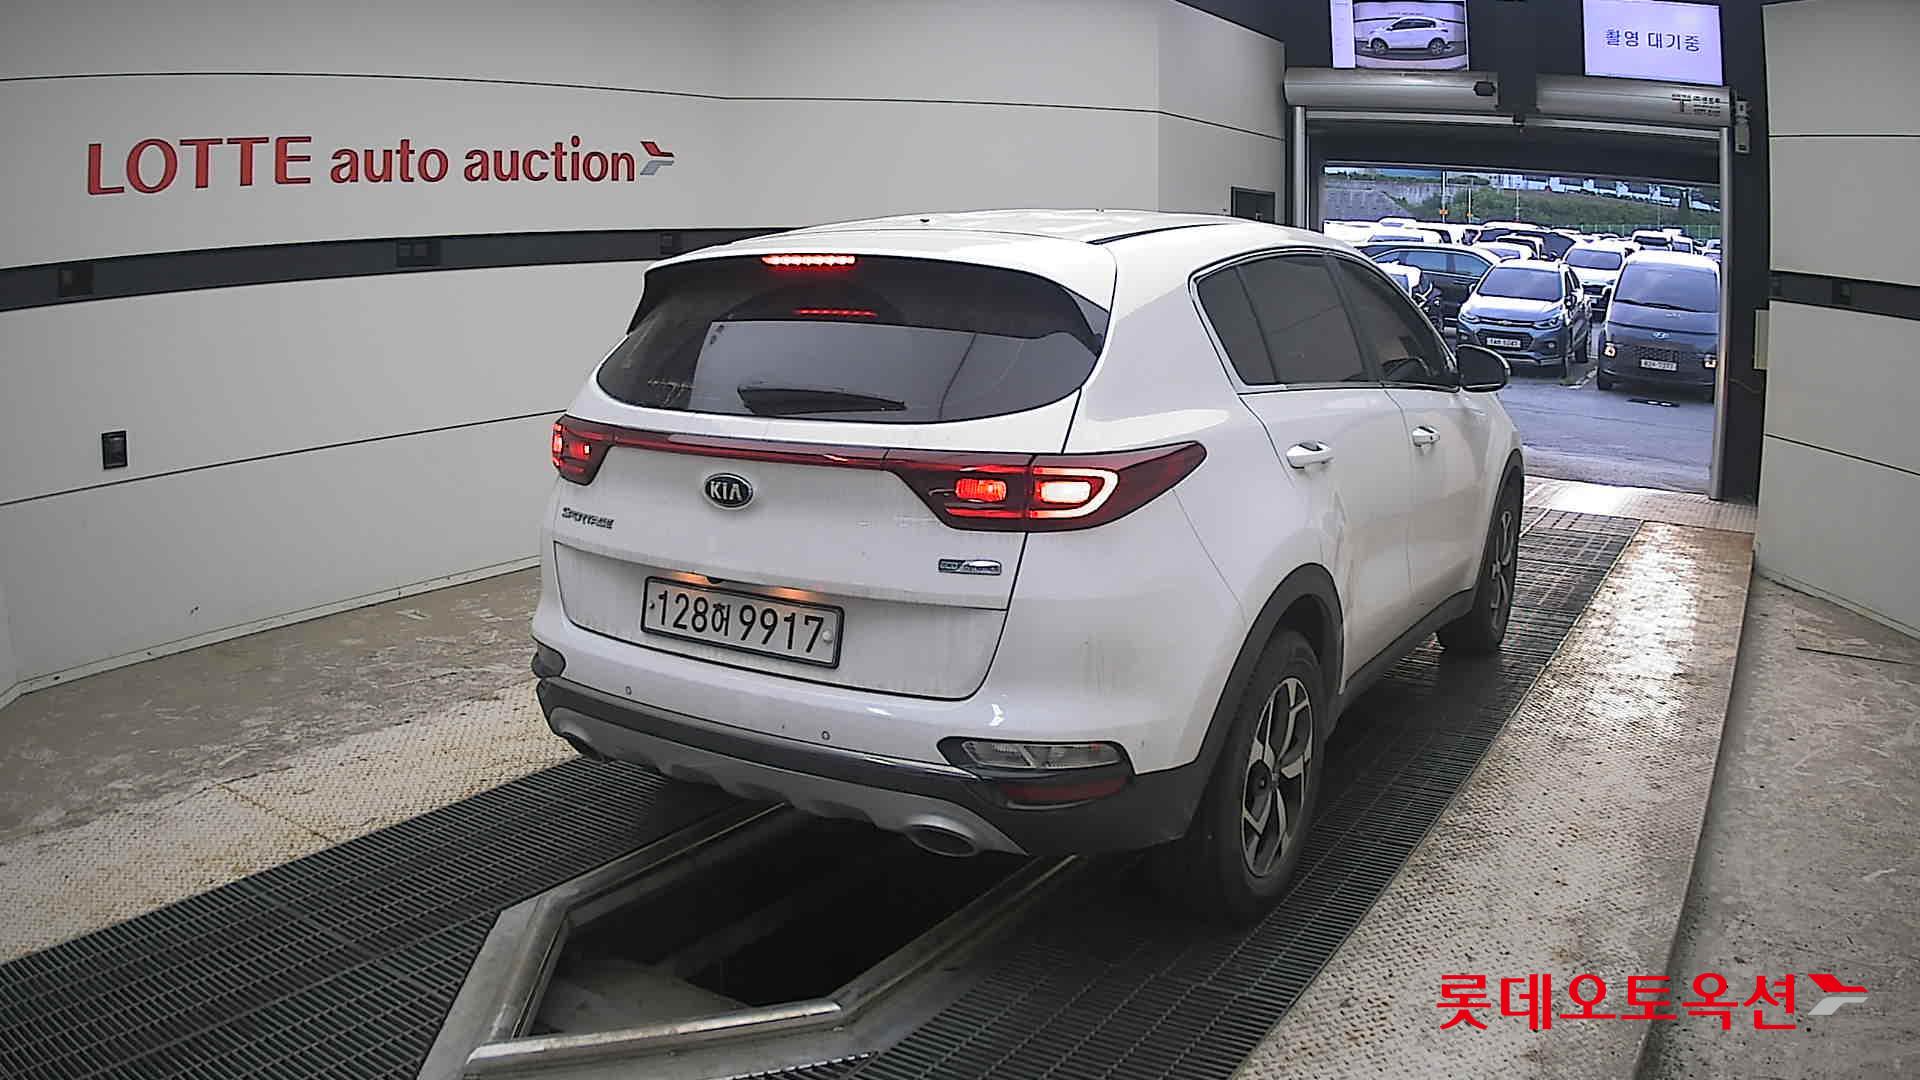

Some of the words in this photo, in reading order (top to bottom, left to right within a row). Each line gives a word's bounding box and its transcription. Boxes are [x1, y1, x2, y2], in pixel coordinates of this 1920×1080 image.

[1647, 31, 1701, 52] 대기중
[87, 135, 312, 196] LOTTE
[329, 138, 449, 184] auto
[463, 135, 636, 182] auction
[710, 480, 743, 501] KIA
